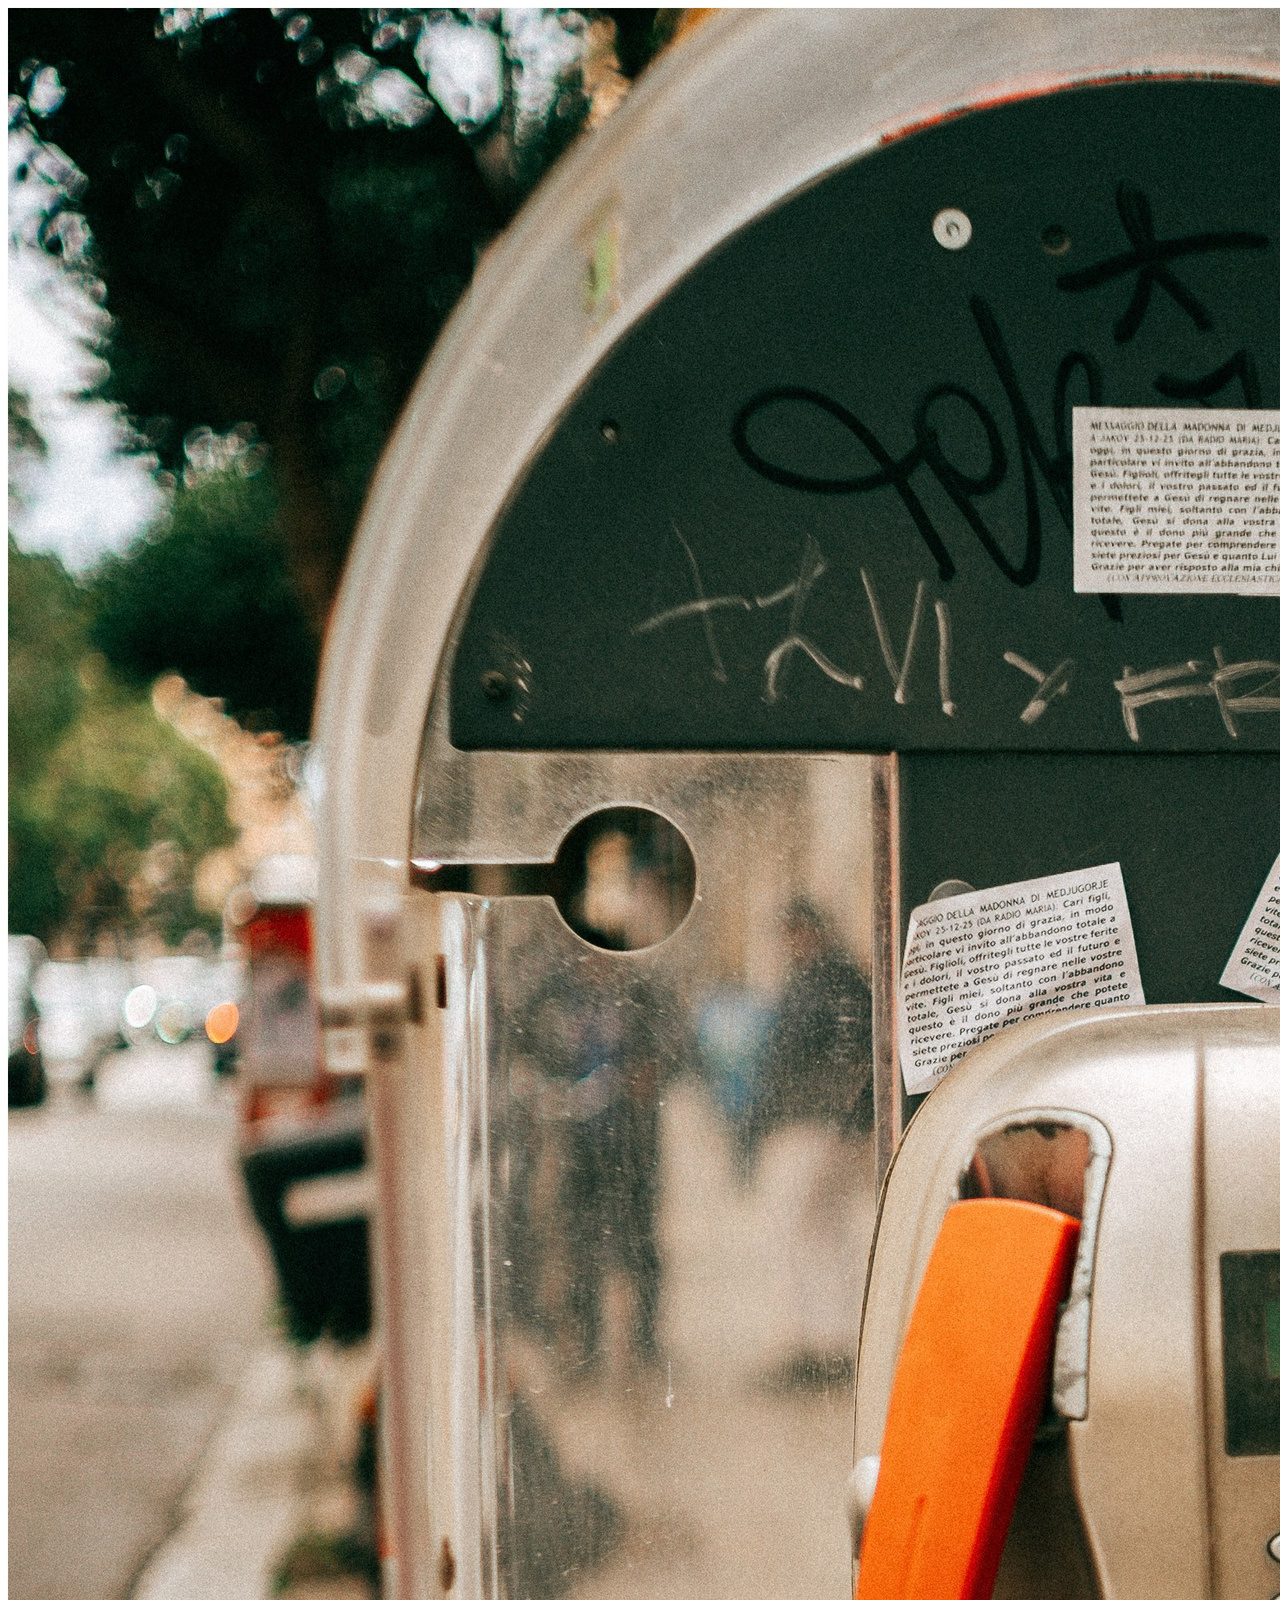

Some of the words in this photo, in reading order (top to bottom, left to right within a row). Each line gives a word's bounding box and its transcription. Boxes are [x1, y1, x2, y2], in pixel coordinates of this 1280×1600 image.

[936, 920, 973, 935] 25-12-25
[977, 917, 992, 927] (DA
[994, 910, 1022, 922] RADIO
[1063, 898, 1084, 908] Cari
[1088, 892, 1111, 904] figli,
[946, 908, 975, 921] DELLA
[980, 897, 1025, 912] MADONNA
[1030, 893, 1040, 903] DI
[1046, 880, 1108, 899] MEDJUGORJE
[925, 941, 935, 949] in
[939, 933, 974, 947] questo
[977, 926, 1011, 940] giorno
[1015, 921, 1026, 930] di
[1030, 915, 1065, 929] grazia,
[1070, 911, 1080, 919] in
[1085, 904, 1114, 915] modo
[955, 945, 965, 954] vi
[967, 940, 997, 952] invito
[1000, 925, 1073, 945] all'abbandono
[1076, 917, 1106, 929] totale
[930, 958, 966, 972] Figlioli,
[969, 948, 1013, 963] offritegli
[1015, 943, 1041, 954] tutte
[1044, 940, 1053, 948] le
[1055, 934, 1088, 945] vostre
[1090, 927, 1118, 938] ferite
[1241, 957, 1272, 975] Grazie
[1245, 948, 1269, 961] siete
[905, 984, 959, 1002] permettete
[973, 976, 999, 986] Gesù
[1003, 971, 1013, 980] di
[1017, 964, 1058, 977] regnare
[1061, 957, 1087, 967] nelle
[1090, 950, 1122, 961] vostre
[906, 1002, 927, 1012] vite.
[932, 995, 954, 1006] Figli
[959, 990, 984, 1001] miei,
[990, 980, 1033, 994] soltanto
[1038, 975, 1057, 984] con
[1062, 961, 1124, 979] l'abbandono
[907, 1011, 939, 1023] totale,
[946, 1003, 972, 1015] Gesù
[979, 1000, 989, 1008] si
[995, 995, 1022, 1005] dona
[1028, 989, 1047, 998] alla
[1054, 980, 1087, 992] vostra
[1094, 974, 1113, 983] vita
[908, 1022, 943, 1035] questo
[961, 1015, 968, 1024] il
[974, 1011, 1001, 1021] dono
[1007, 1006, 1023, 1016] più
[1029, 995, 1065, 1011] grande
[1071, 991, 1089, 1000] che
[1095, 983, 1128, 997] potete
[914, 1056, 948, 1068] Grazie
[950, 1051, 967, 1062] per
